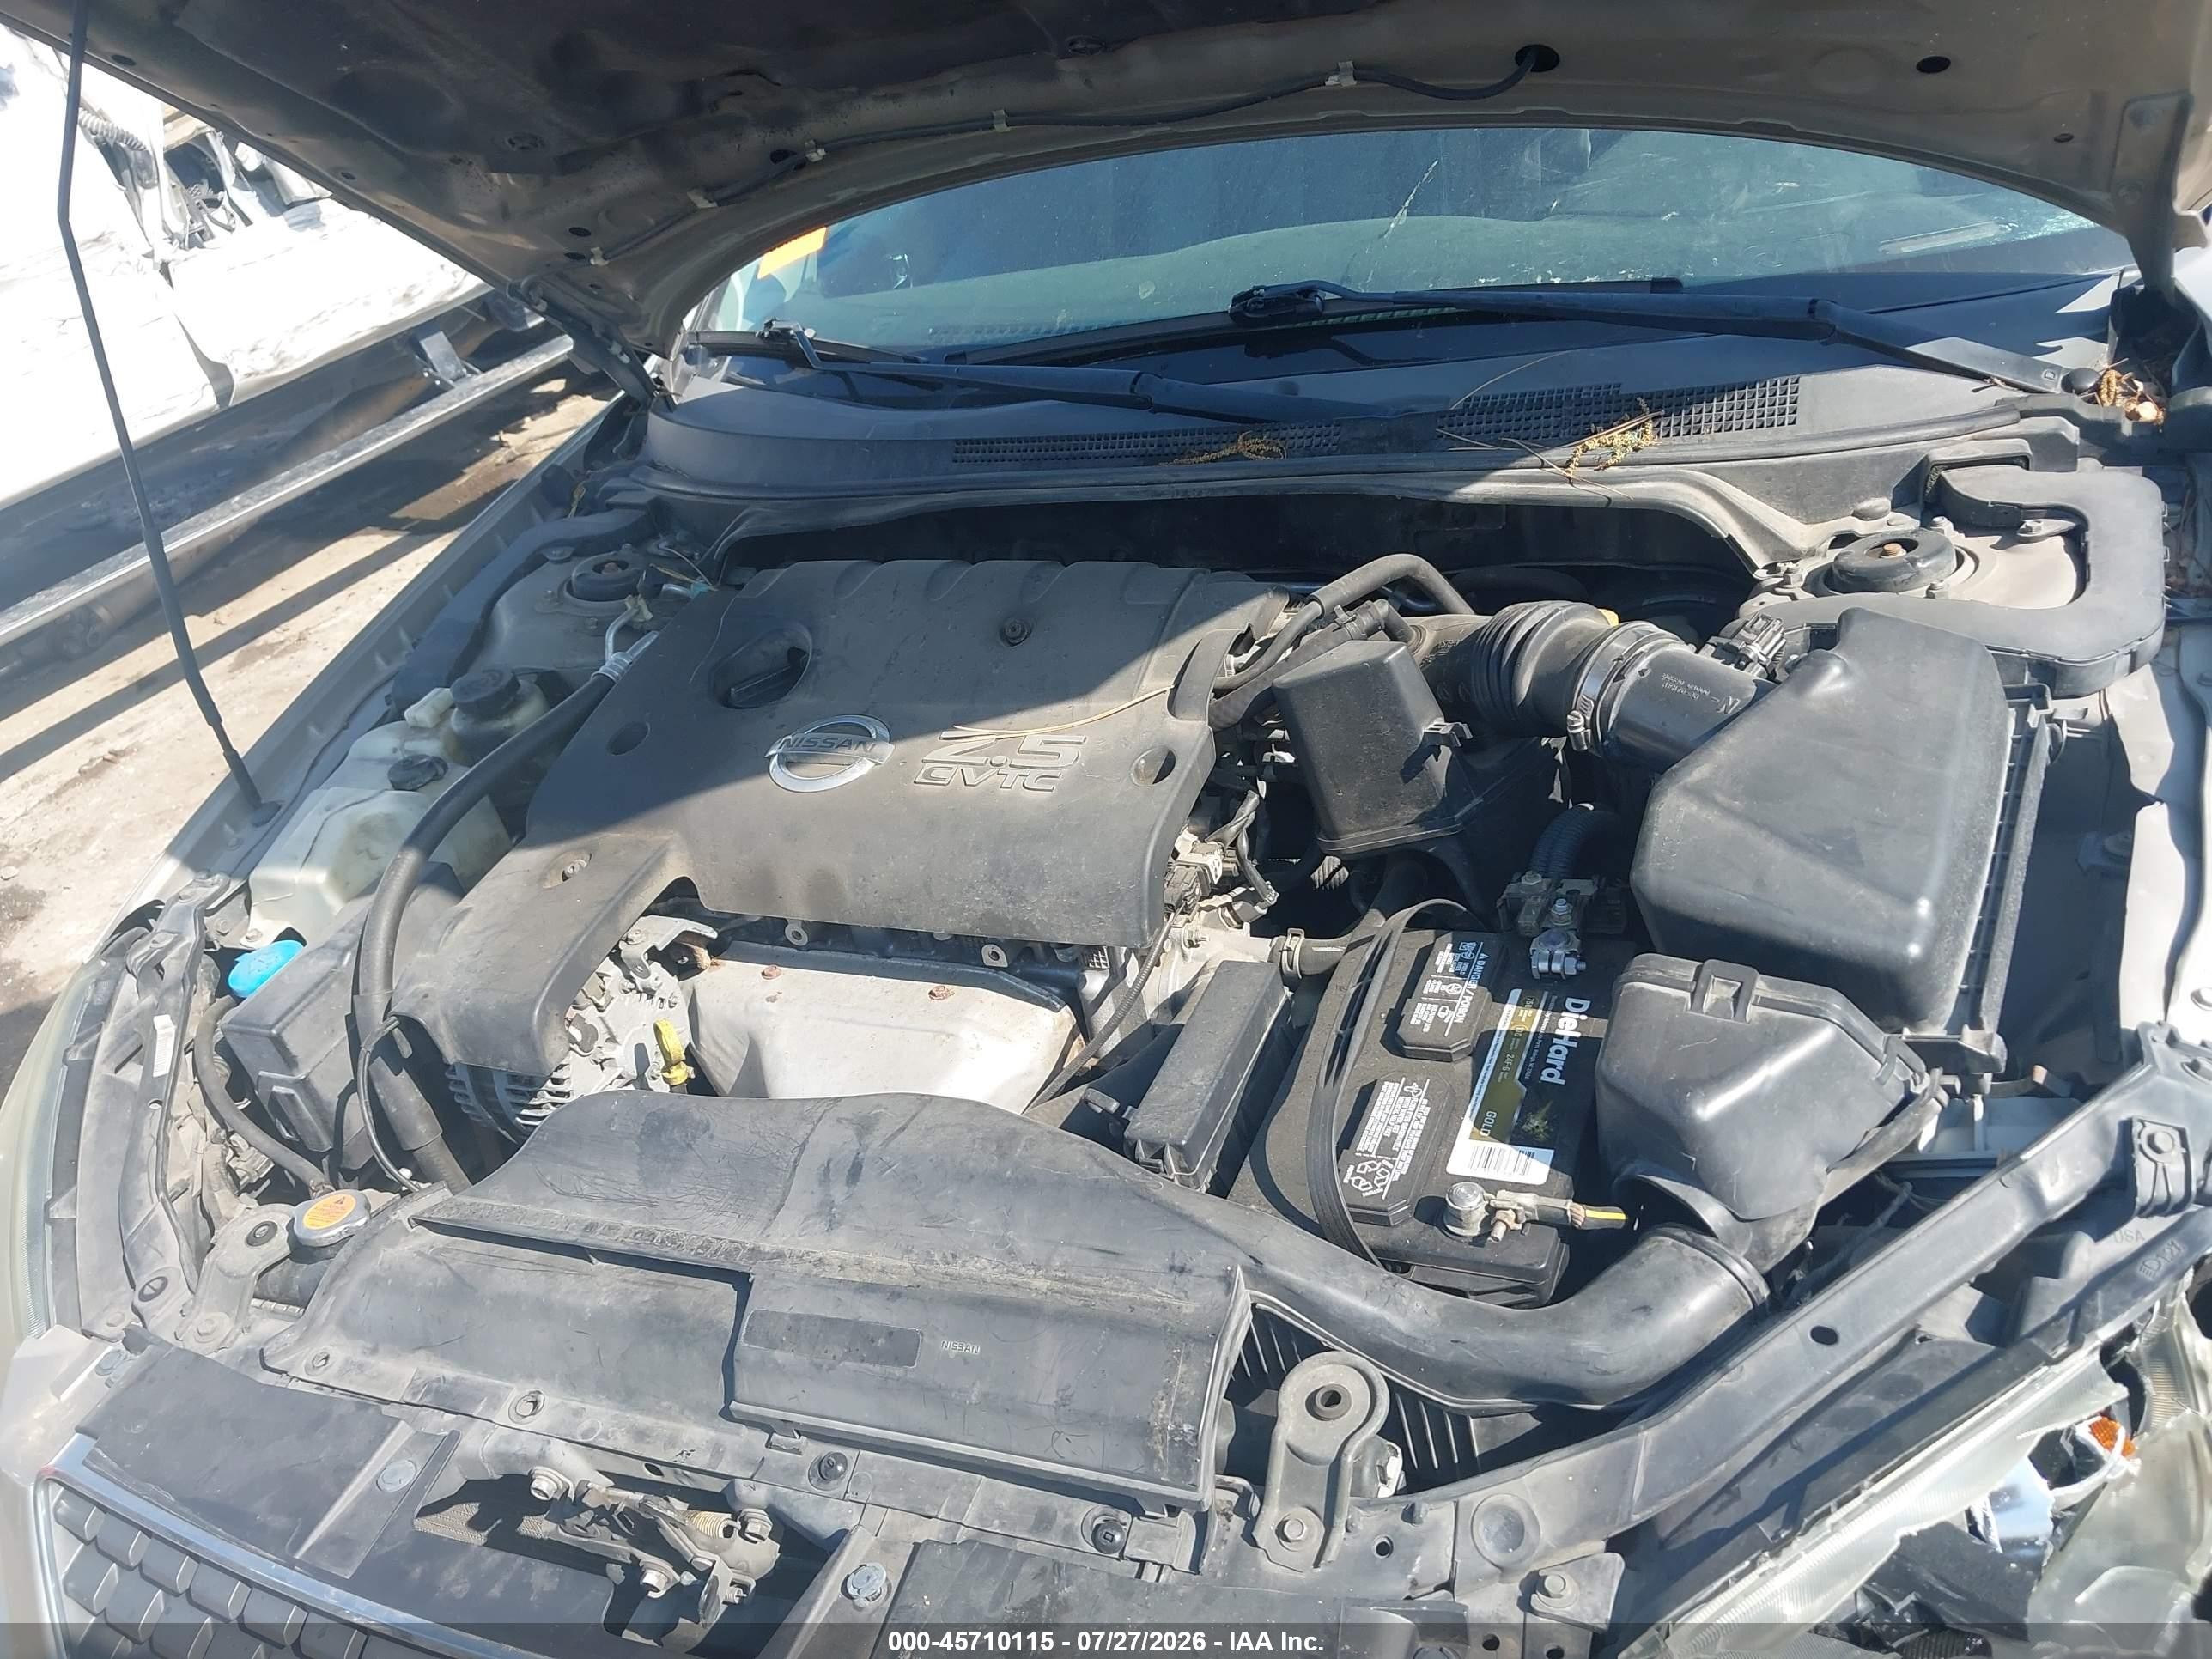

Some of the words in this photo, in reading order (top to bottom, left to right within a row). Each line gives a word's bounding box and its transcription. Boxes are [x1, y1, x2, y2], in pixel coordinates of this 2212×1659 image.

[781, 732, 873, 754] NISSAN
[921, 729, 1087, 770] 2.5
[913, 764, 1062, 793] CVTC
[1468, 961, 1486, 990] DANGER
[1454, 995, 1473, 1023] POISON
[1540, 997, 1591, 1085] DieHard
[1480, 1111, 1498, 1137] GOLD
[2113, 1230, 2145, 1244] USA
[940, 1340, 981, 1355] NISSAN
